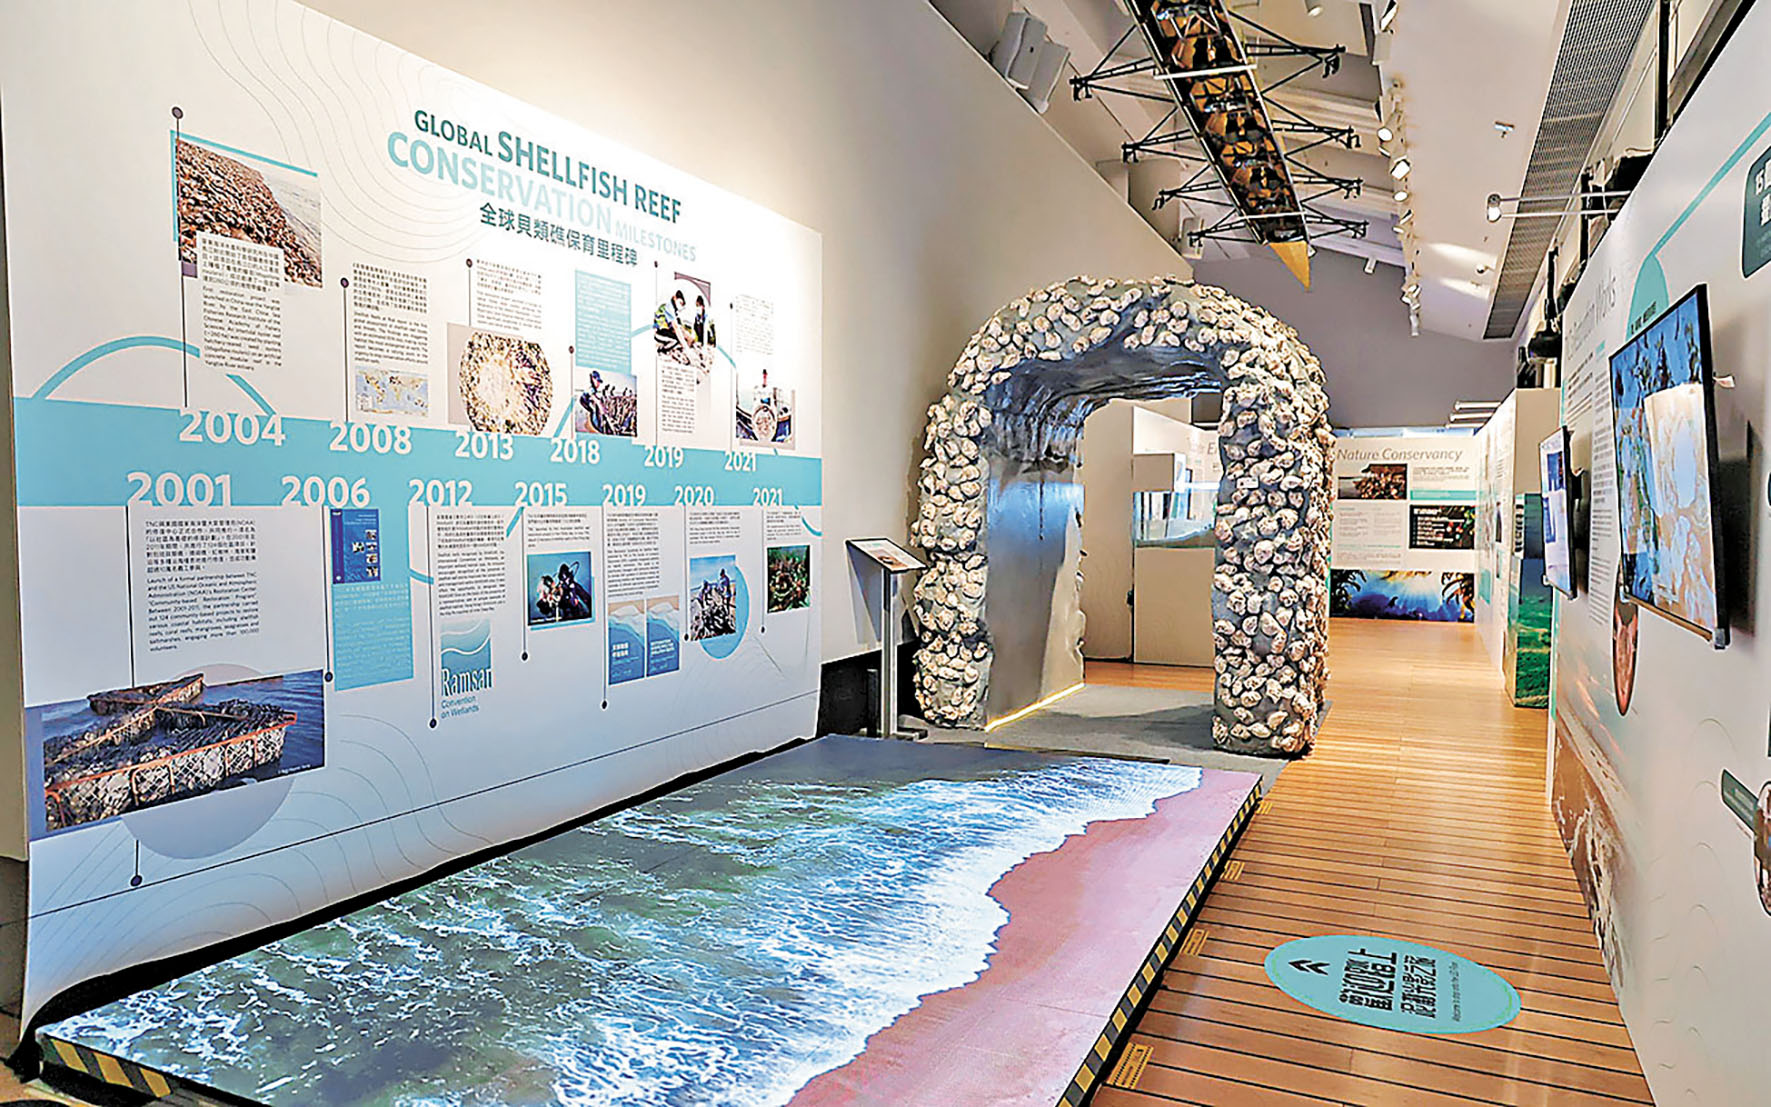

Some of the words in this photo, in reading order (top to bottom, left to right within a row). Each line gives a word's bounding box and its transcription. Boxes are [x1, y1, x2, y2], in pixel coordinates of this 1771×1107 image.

[414, 109, 493, 157] GLOBAL
[498, 130, 628, 206] SHELLFISH
[634, 183, 682, 224] REEF
[387, 131, 611, 235] CONSERVATION
[615, 218, 697, 263] MILESTONES
[180, 410, 286, 446] 2004
[329, 420, 412, 454] 2008
[455, 431, 515, 460] 2013
[551, 437, 601, 464] 2018
[644, 445, 684, 469] 2019
[724, 451, 757, 472] 2021
[1337, 449, 1380, 461] Nature
[1382, 448, 1463, 462] Conservancy
[127, 471, 232, 507] 2001
[282, 475, 371, 508] 2006
[409, 479, 473, 507] 2012
[514, 482, 568, 507] 2015
[602, 484, 647, 507] 2019
[674, 486, 715, 507] 2020
[753, 488, 783, 507] 2021
[441, 668, 493, 697] Ramsar
[441, 696, 476, 709] Convention
